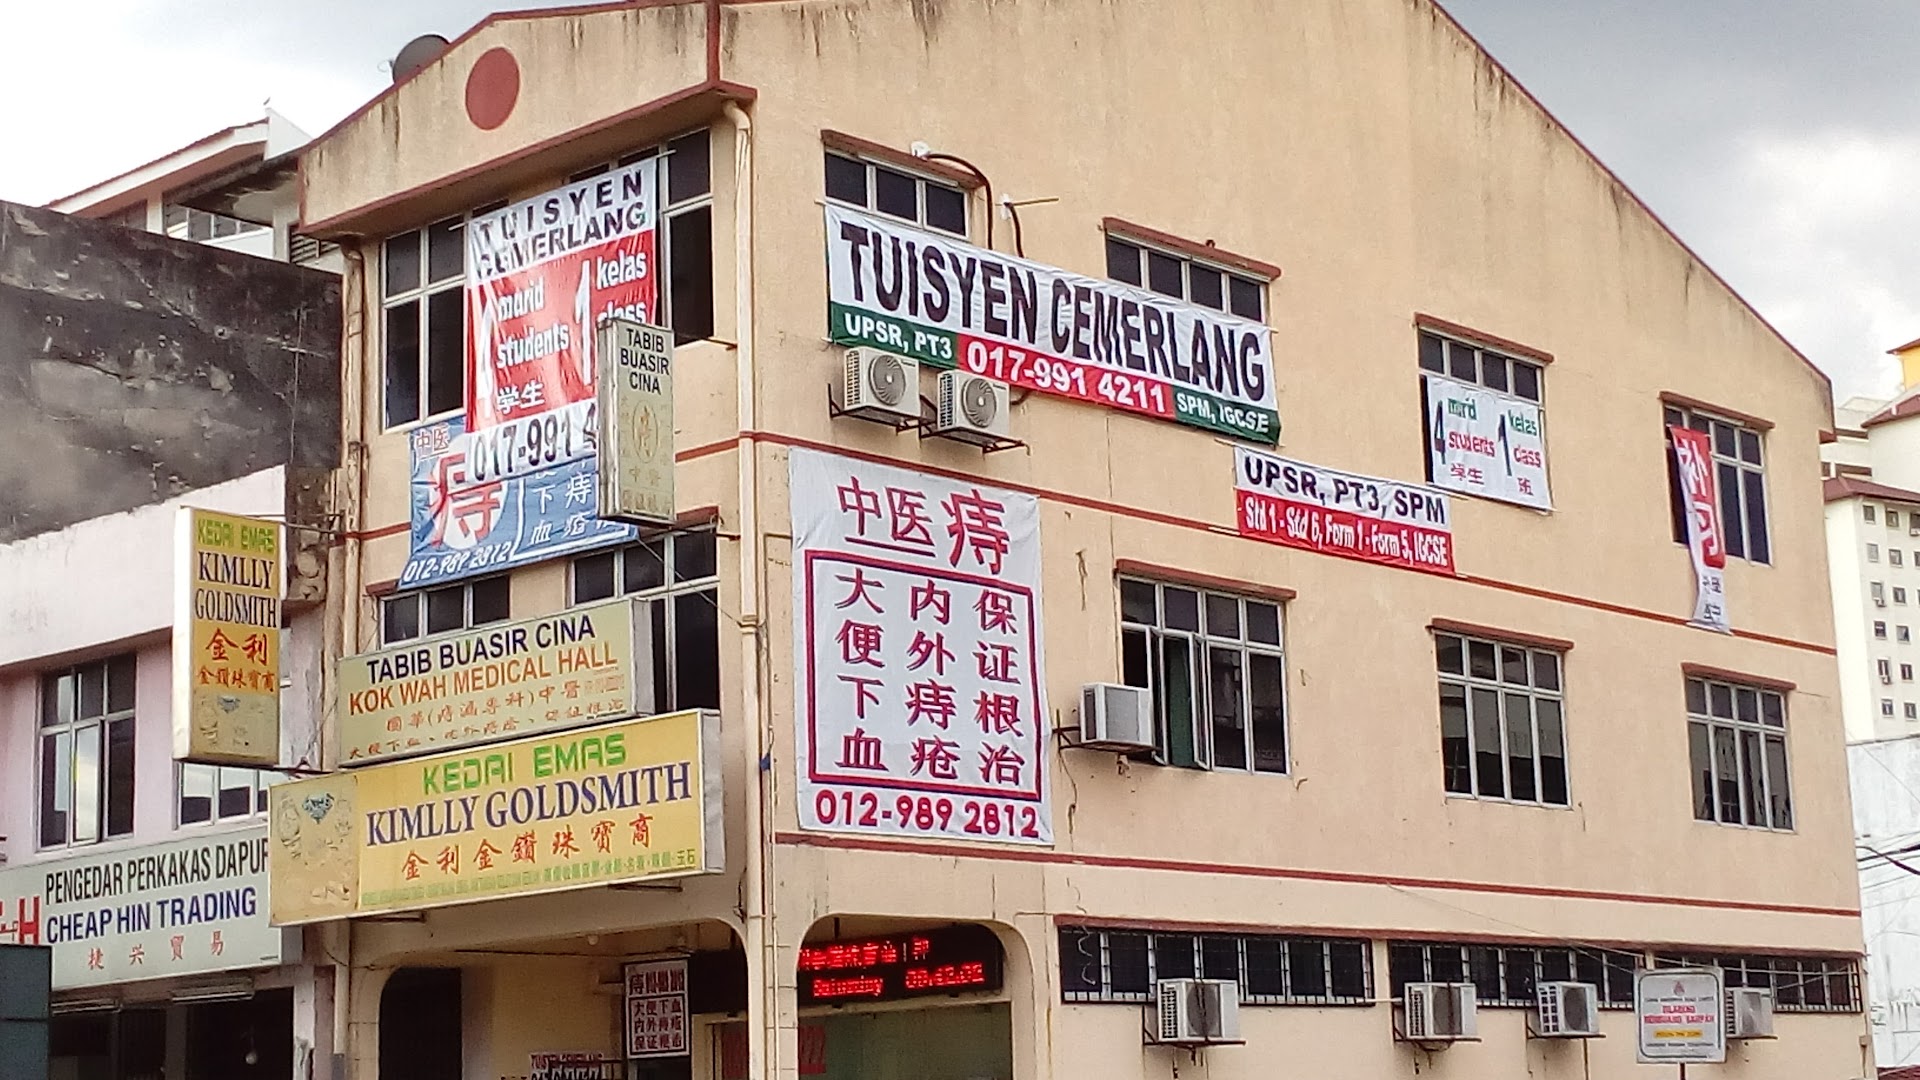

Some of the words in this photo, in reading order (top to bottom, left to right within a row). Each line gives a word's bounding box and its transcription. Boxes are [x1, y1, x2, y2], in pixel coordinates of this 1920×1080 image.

[479, 169, 642, 243] TUISYEN
[498, 276, 544, 321] murid
[597, 250, 646, 290] kelas
[575, 259, 591, 386] 1
[840, 221, 1038, 344] TUISYEN
[1051, 277, 1266, 401] CEMERLANG
[845, 311, 909, 354] UPSR,
[914, 331, 953, 361] PT3
[496, 324, 569, 369] students
[620, 347, 669, 375] BUASIR
[626, 328, 664, 353] TABIB
[496, 379, 545, 415] 学生
[629, 371, 661, 395] CINA
[967, 341, 1087, 396] 017-991
[1098, 371, 1166, 413] 4211
[416, 421, 450, 450] 中医
[1177, 394, 1216, 423] SPM,
[1219, 404, 1269, 434] IGCSE
[1434, 400, 1446, 464] 4
[473, 408, 573, 481] 017-991
[1498, 414, 1512, 476] 1
[1244, 455, 1326, 505] UPSR,
[1332, 478, 1387, 519] PT3,
[1394, 489, 1446, 524] SPM
[198, 519, 233, 547] KEDAI
[241, 525, 275, 552] EMAS
[1246, 497, 1266, 529] Std
[1269, 504, 1276, 533] 1
[1286, 507, 1308, 538] Std
[1325, 514, 1355, 548] Form
[1372, 528, 1400, 557] Form
[1414, 533, 1447, 566] IGCSE
[199, 551, 275, 590] KIMLLY
[403, 553, 467, 582] 012-989
[195, 588, 277, 628] GOLDSMITH
[206, 628, 268, 666] 金利
[366, 648, 432, 684] TABIB
[440, 628, 528, 669] BUASIR
[536, 614, 595, 648] CINA
[834, 568, 889, 772] 大便下血
[349, 687, 395, 715] KOK
[399, 675, 447, 705] WAH
[453, 659, 551, 695] MEDICAL
[557, 640, 618, 676] HALL
[905, 578, 961, 780] 内外痔疮
[973, 589, 1026, 787] 保证根治
[422, 754, 514, 795] KEDAI
[534, 733, 627, 778] EMAS
[366, 794, 483, 846] KIMLLY
[485, 761, 692, 828] GOLDSMITH
[815, 789, 953, 832] 012-989
[964, 801, 1040, 838] 2812
[46, 862, 123, 905] PENGEDAR
[127, 847, 210, 893] PERKAKAS
[47, 908, 113, 944] CHEAP
[117, 902, 150, 933] HIN
[156, 886, 256, 928] TRADING
